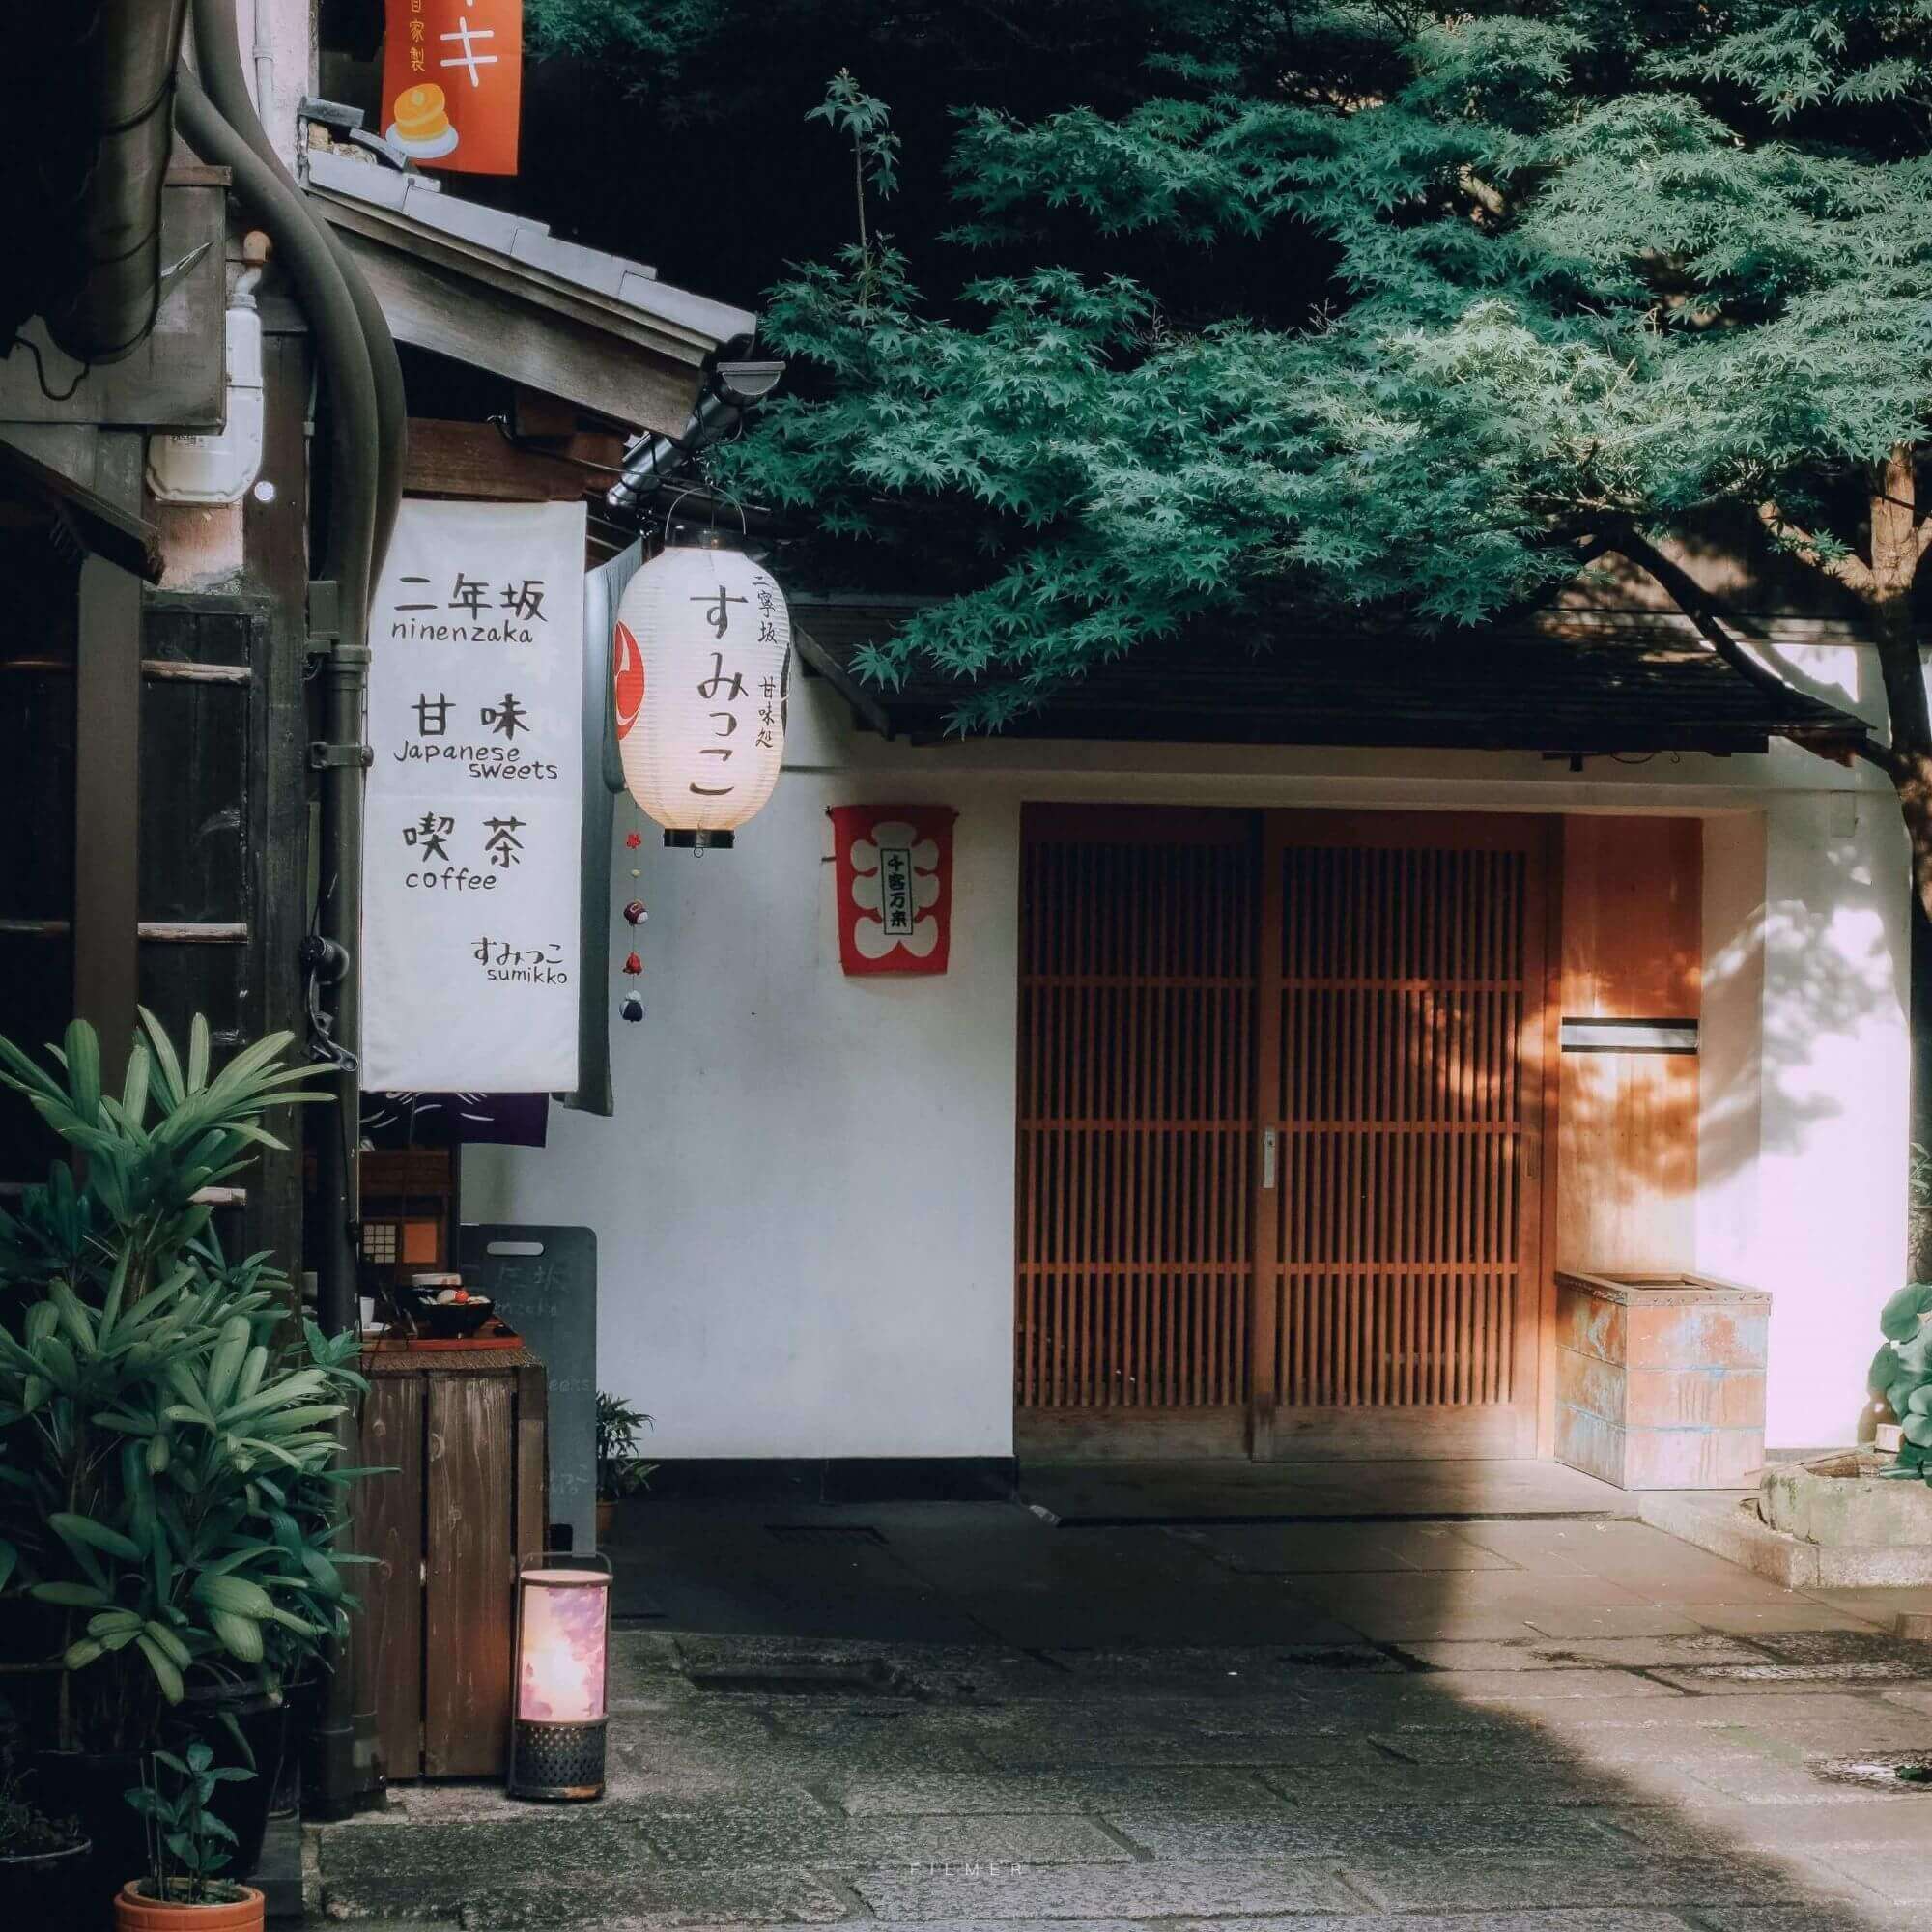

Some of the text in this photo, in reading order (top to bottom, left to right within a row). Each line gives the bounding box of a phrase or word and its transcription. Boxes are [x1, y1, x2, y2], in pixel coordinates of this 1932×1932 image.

[440, 0, 498, 87] キ
[394, 573, 548, 622] 二年坂
[391, 617, 533, 643] ninenzaka
[689, 585, 749, 796] すみっこ
[411, 692, 530, 741] 甘味
[393, 740, 521, 763] Japanese
[469, 761, 558, 780] sweets
[402, 811, 526, 868] 喫茶
[405, 867, 497, 891] coffee
[487, 967, 567, 985] sumikko
